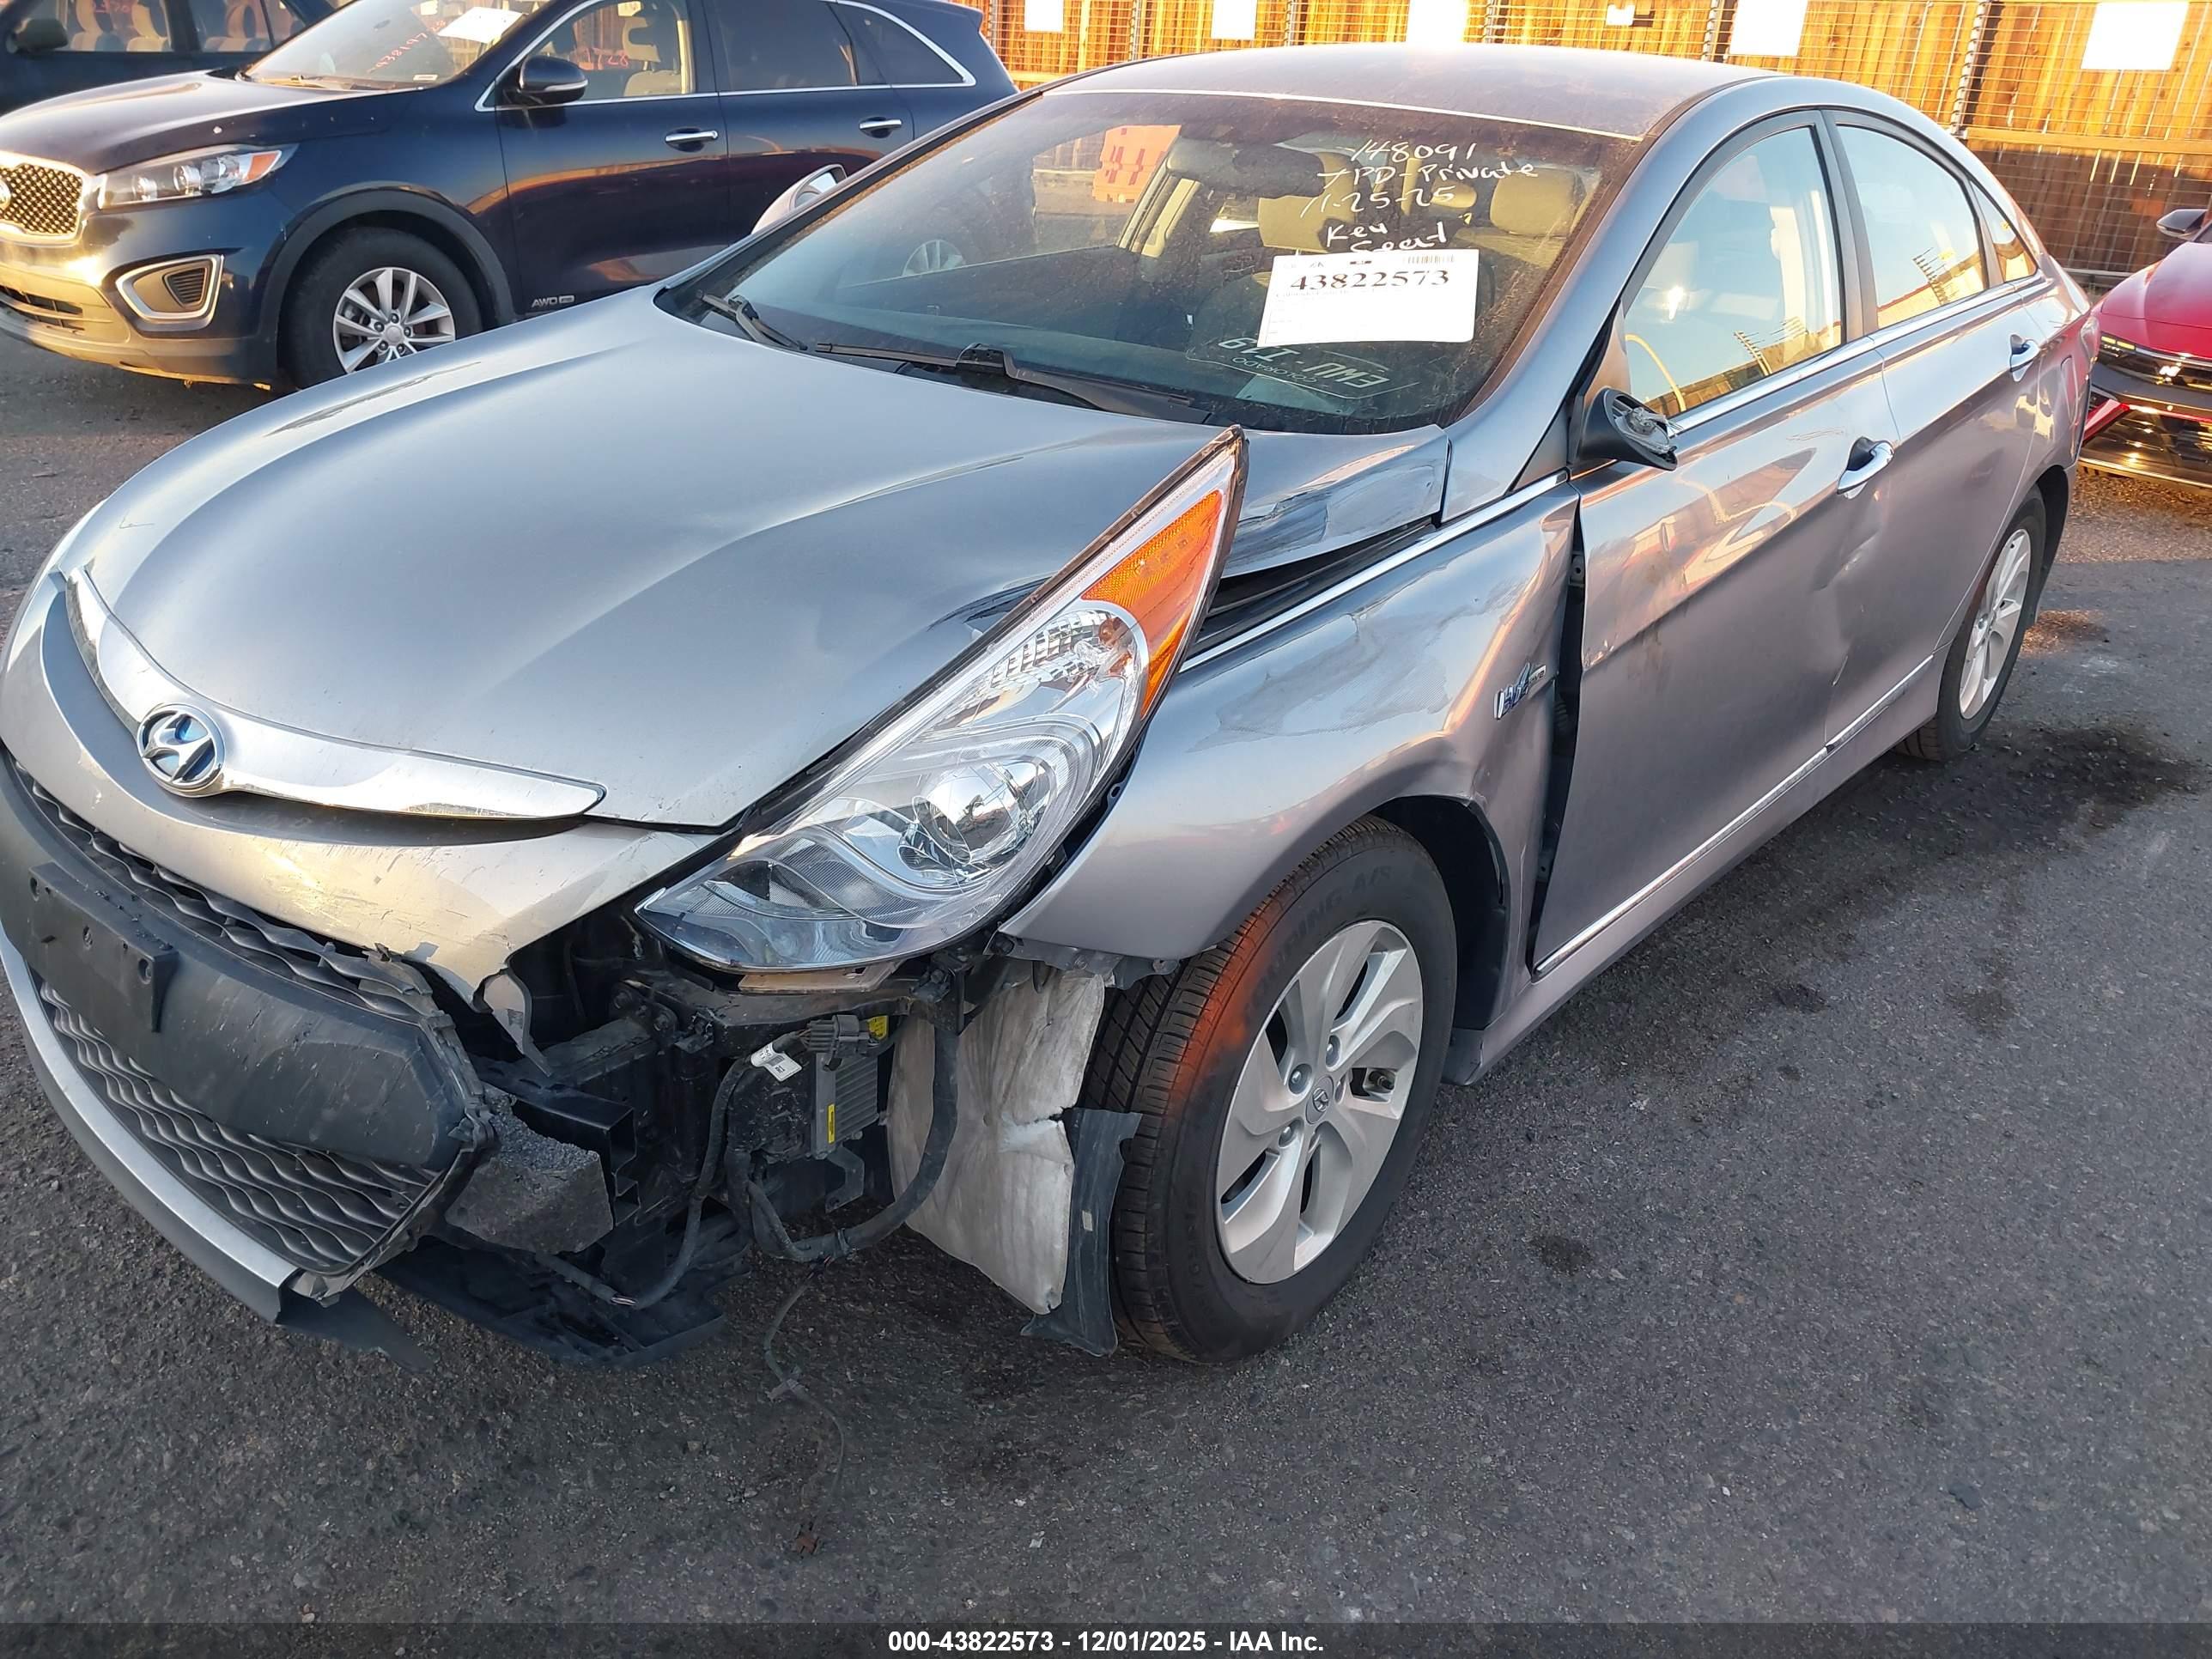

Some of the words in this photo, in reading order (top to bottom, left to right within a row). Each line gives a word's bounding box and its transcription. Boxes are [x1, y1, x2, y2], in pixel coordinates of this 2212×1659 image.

[1351, 138, 1477, 162] 148091
[1299, 185, 1455, 218] 11-25-25
[1289, 269, 1449, 293] 43822573
[531, 296, 558, 308] AWD
[1231, 356, 1318, 384] COLORADO
